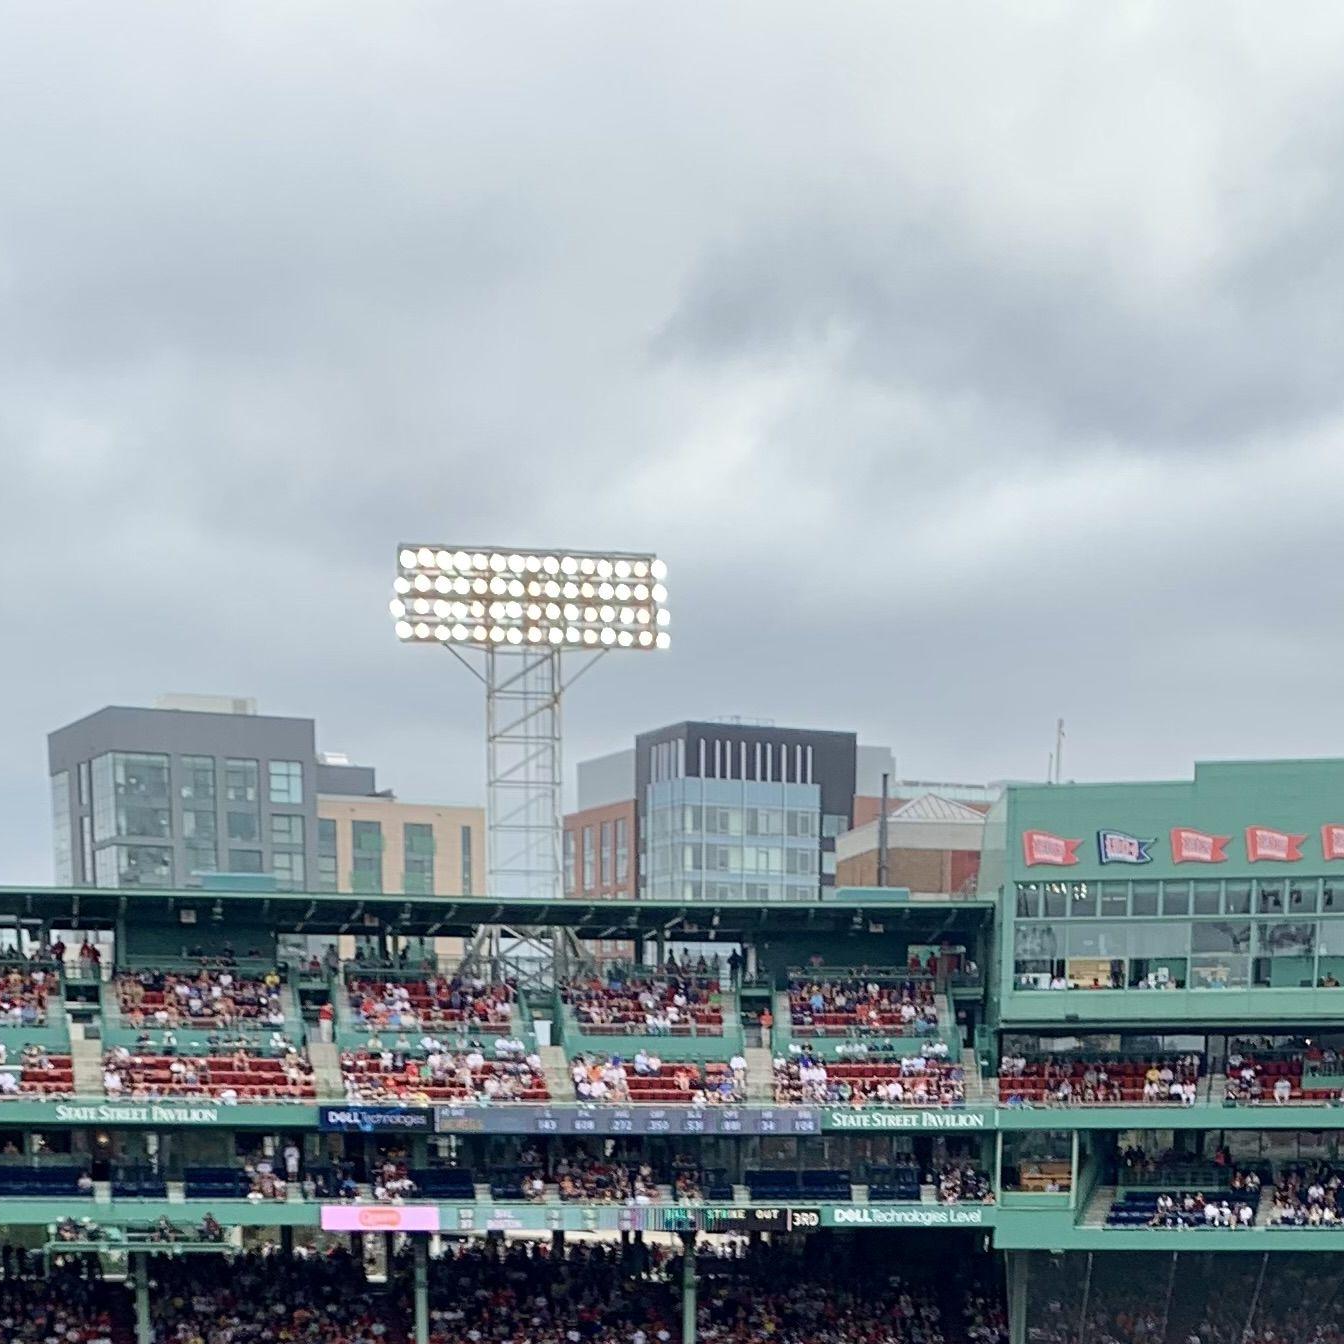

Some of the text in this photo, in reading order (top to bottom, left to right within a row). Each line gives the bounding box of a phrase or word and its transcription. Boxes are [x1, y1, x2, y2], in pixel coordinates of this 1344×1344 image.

[56, 1106, 217, 1121] STATE STREET PAVILION
[832, 1112, 984, 1127] STATE STREET PAVILION
[792, 1212, 819, 1227] 3RD
[834, 1208, 982, 1226] DELL Technologies Level
